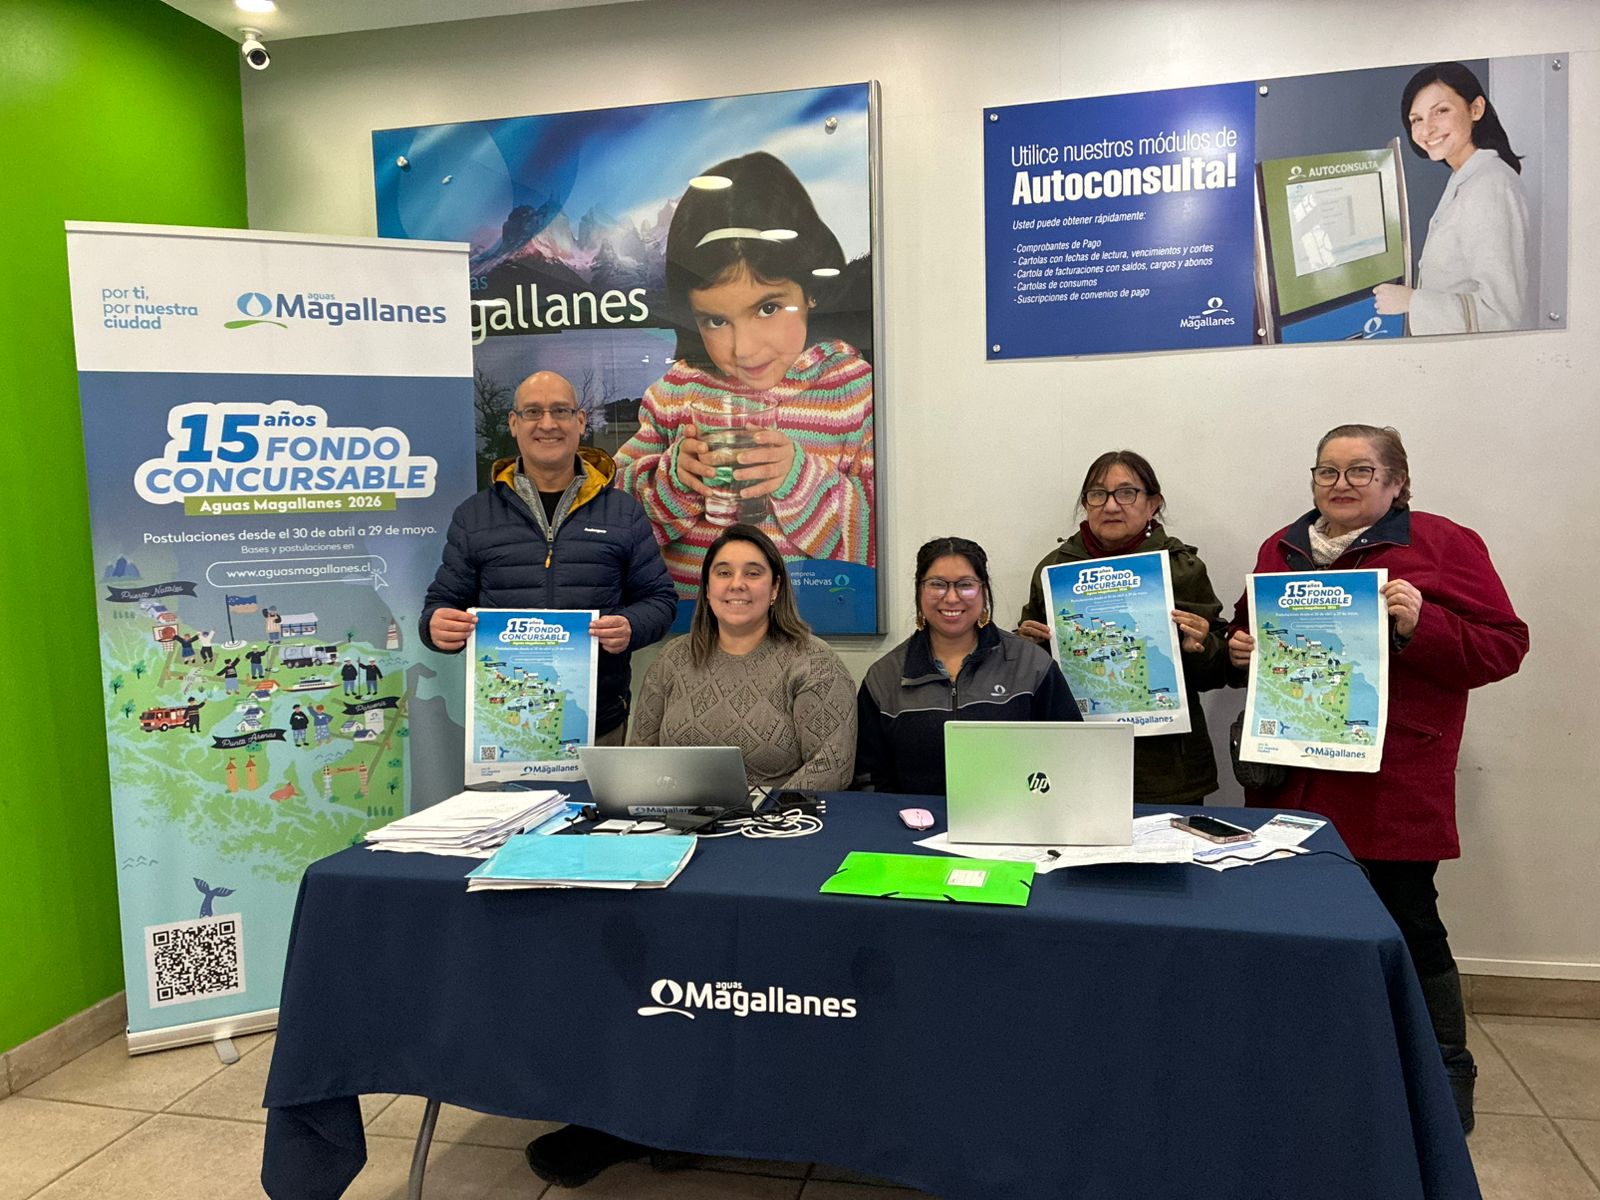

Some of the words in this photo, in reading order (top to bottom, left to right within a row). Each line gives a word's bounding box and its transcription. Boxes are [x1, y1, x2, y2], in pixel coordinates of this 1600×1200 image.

[1011, 144, 1059, 167] Utilice
[1063, 138, 1134, 162] nuestros
[1139, 127, 1210, 155] módulos
[1215, 126, 1237, 148] de
[1308, 160, 1379, 177] AUTOCONSULTA
[1012, 152, 1237, 205] Autoconsulta!
[1013, 219, 1035, 230] Usted
[1036, 218, 1060, 230] puede
[1062, 215, 1092, 226] obtener
[1094, 211, 1147, 225] rápidamente:
[1071, 240, 1080, 249] de
[1082, 239, 1102, 249] Pago
[1049, 255, 1063, 263] con
[1065, 252, 1089, 262] fechas
[1090, 251, 1100, 260] de
[1102, 251, 1128, 259] lectura,
[1131, 246, 1181, 257] vencimientos
[1182, 246, 1188, 256] y
[1189, 244, 1214, 253] cortes
[1044, 267, 1053, 277] de
[1055, 265, 1104, 276] facturaciones
[1106, 264, 1120, 272] con
[1122, 262, 1148, 272] saldos,
[1150, 260, 1176, 270] cargos
[1177, 260, 1183, 270] y
[1184, 257, 1213, 267] abonos
[1048, 280, 1058, 289] de
[1059, 279, 1098, 288] consumos
[102, 287, 128, 302] por
[133, 286, 149, 301] ti,
[307, 292, 336, 302] aguas
[1070, 291, 1079, 300] de
[1080, 289, 1118, 300] convenios
[1120, 288, 1130, 297] de
[1130, 288, 1150, 298] pago
[103, 302, 132, 318] por
[134, 303, 199, 317] nuestra
[276, 293, 447, 326] Magallanes
[471, 283, 649, 346] gallanes
[103, 316, 162, 331] ciudad
[1180, 317, 1236, 330] Magallanes
[176, 413, 261, 464] 15
[264, 411, 317, 427] años
[266, 436, 401, 462] FONDO
[145, 465, 428, 494] CONCURSABLE
[200, 499, 250, 514] Aguas
[254, 496, 342, 512] Magallanes
[347, 495, 382, 509] 2026
[143, 529, 236, 544] Postulaciones
[238, 528, 276, 541] desde
[279, 528, 290, 540] el
[292, 527, 309, 540] 30
[310, 527, 326, 539] de
[328, 526, 355, 538] abril
[357, 528, 367, 537] a
[368, 525, 383, 537] 29
[385, 525, 400, 537] de
[402, 525, 437, 537] mayo.
[241, 545, 269, 555] Bases
[271, 546, 277, 556] y
[279, 542, 341, 555] postulaciones
[343, 542, 355, 551] en
[226, 562, 371, 580] www.aguasmagallanes.cl
[1081, 571, 1100, 584] 15
[1100, 572, 1131, 582] FONDO
[803, 578, 832, 586] Nuevas
[1075, 578, 1138, 592] CONCURSABLE
[1287, 585, 1306, 598] 15
[1307, 589, 1341, 597] FONDO
[1281, 597, 1349, 606] CONCURSABLE
[508, 621, 528, 633] 15
[502, 633, 567, 641] CONCURSABLE
[1126, 715, 1174, 725] Magallanes
[222, 739, 246, 747] Punta
[248, 732, 276, 743] Arenas
[1315, 747, 1366, 759] Magallanes
[533, 765, 579, 774] Magallanes
[1028, 771, 1050, 793] hp
[715, 981, 742, 990] aguas
[685, 981, 857, 1018] Magallanes
